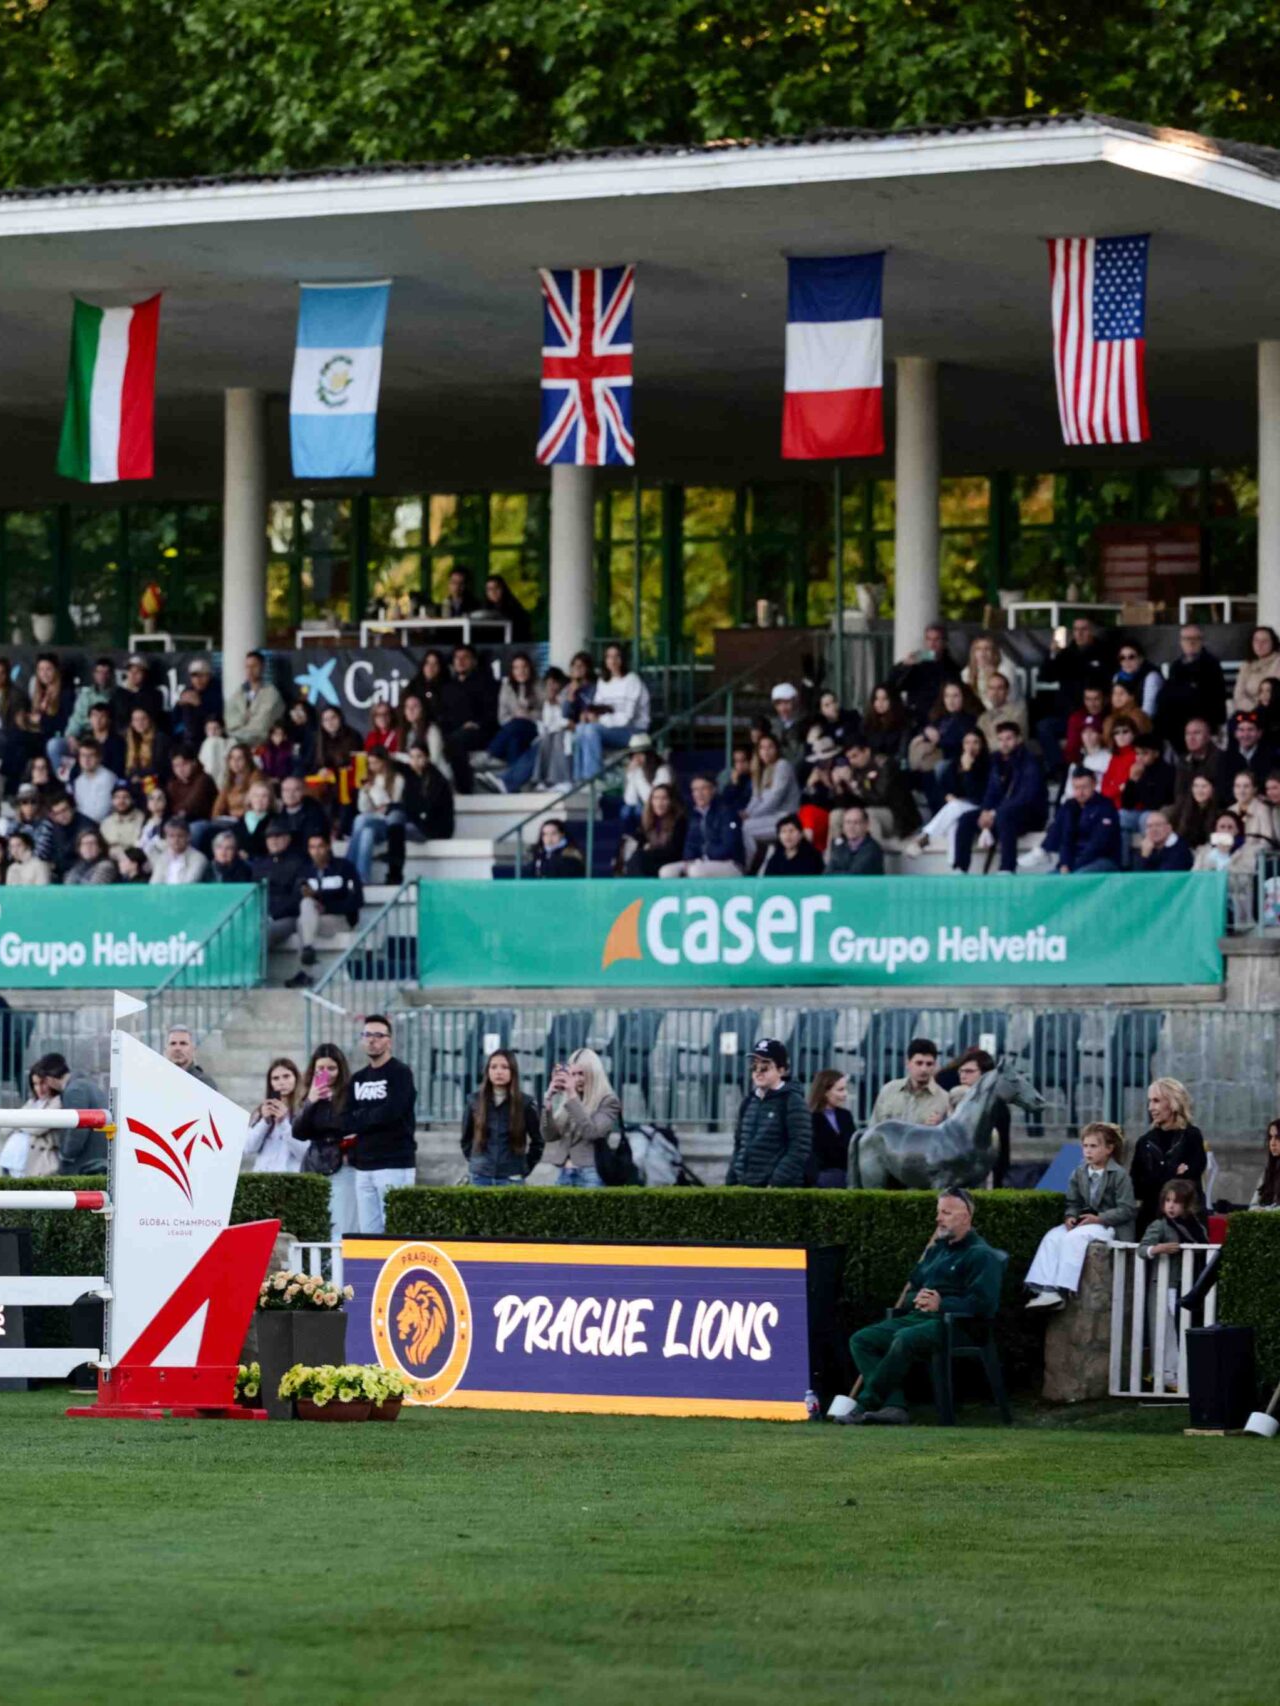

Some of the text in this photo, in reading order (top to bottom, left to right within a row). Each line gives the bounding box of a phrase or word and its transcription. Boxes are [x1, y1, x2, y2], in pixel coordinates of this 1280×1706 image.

[646, 895, 1067, 973] caser Grupo Helvetia
[92, 931, 205, 967] Helvetia
[354, 1079, 388, 1101] VANS
[139, 1217, 222, 1227] GLOBAL CHAMPIONS
[401, 1251, 439, 1267] PRAGUE
[493, 1295, 779, 1362] PRAGUE LIONS
